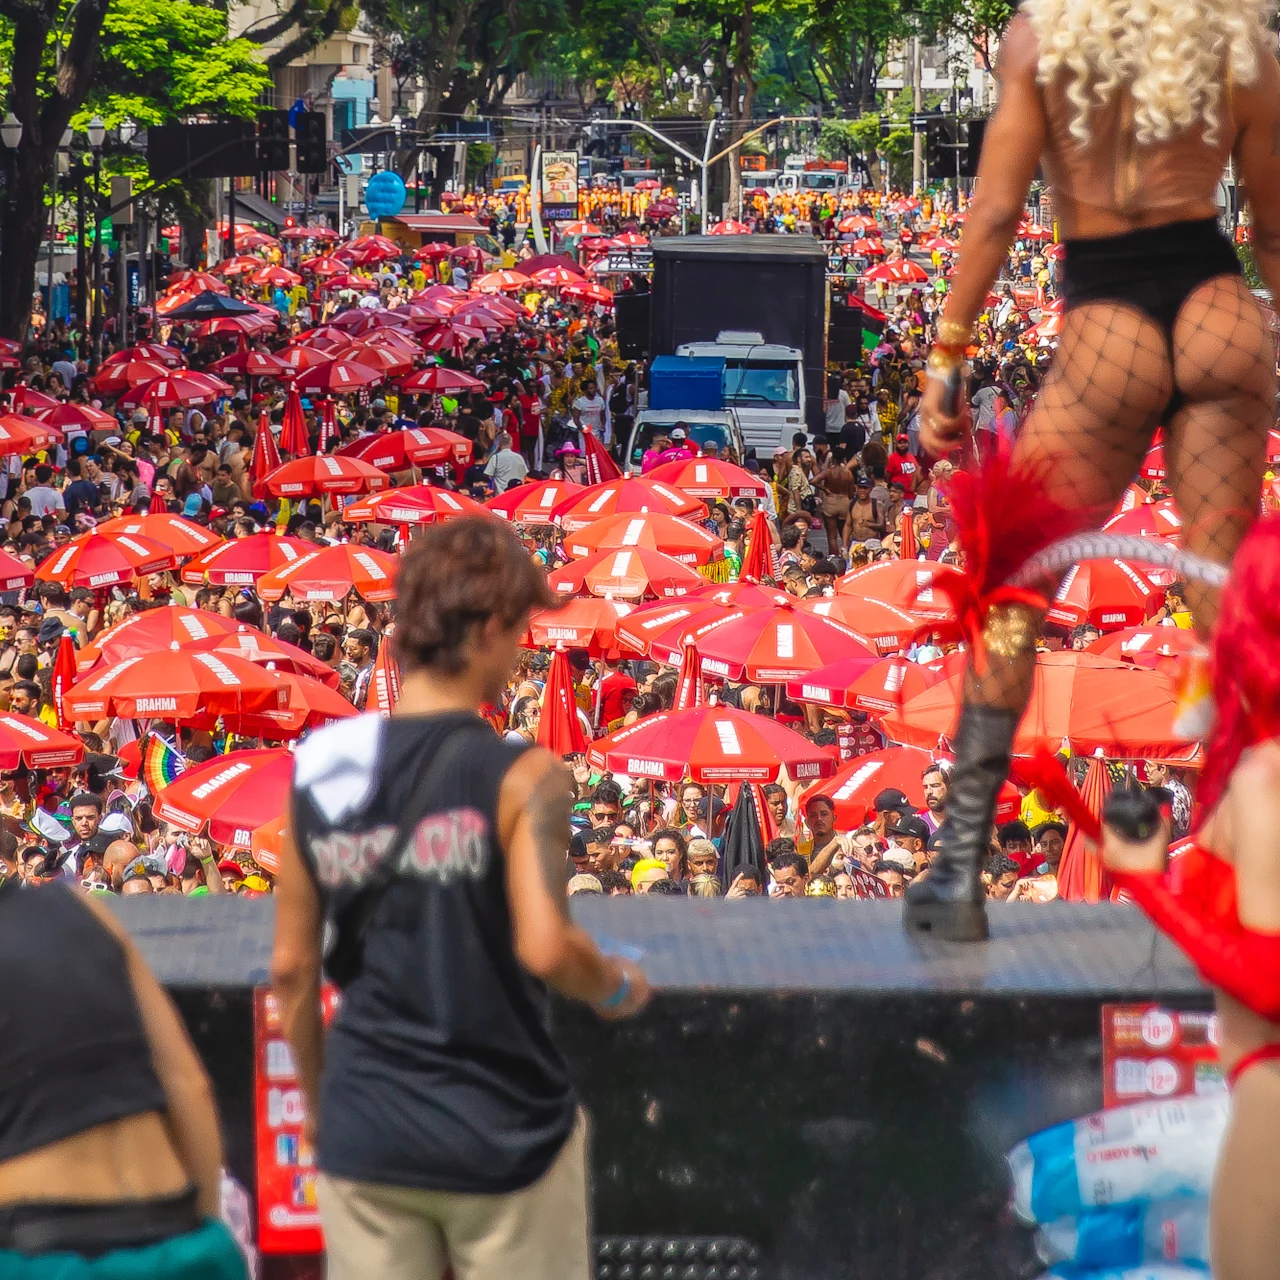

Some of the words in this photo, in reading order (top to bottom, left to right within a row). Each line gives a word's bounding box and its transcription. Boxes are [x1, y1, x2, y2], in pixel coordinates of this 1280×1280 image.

[547, 627, 577, 641] BRAHMA
[701, 657, 729, 675] BRAHMA
[802, 684, 830, 703] BRAHMA
[136, 697, 177, 712] BRAHMA
[627, 759, 665, 777] BRAHMA
[191, 763, 251, 799] BRAHMA
